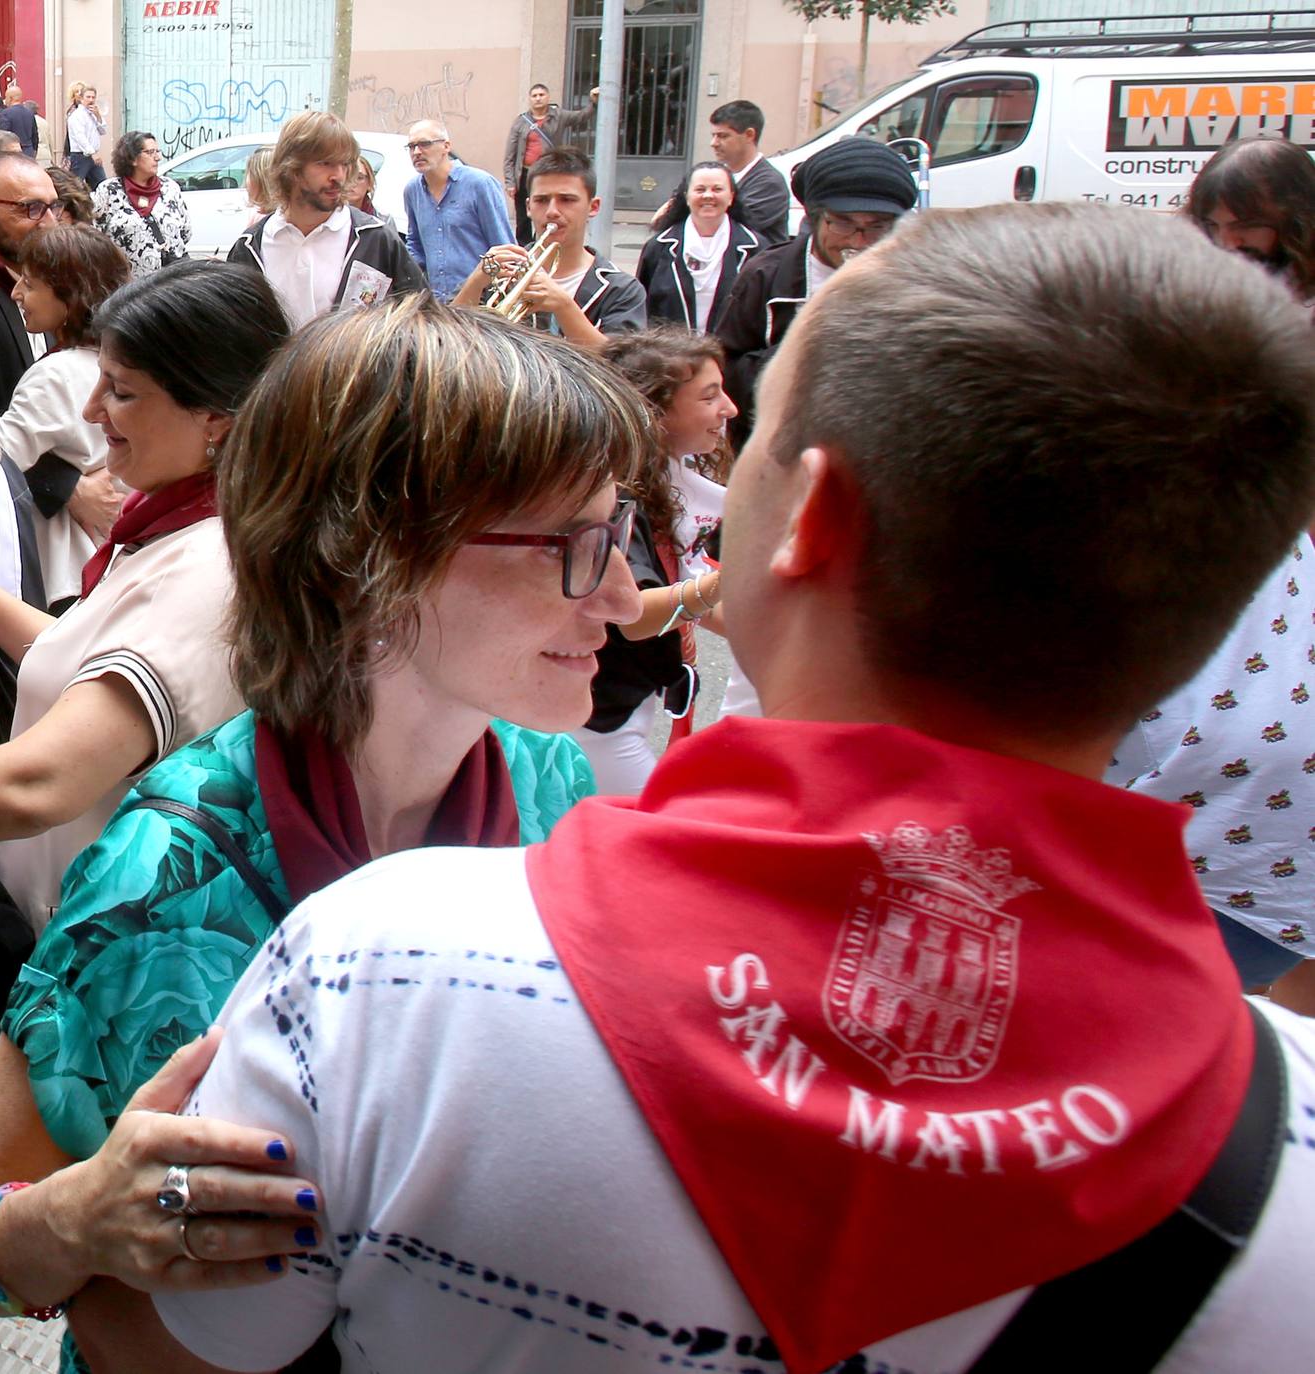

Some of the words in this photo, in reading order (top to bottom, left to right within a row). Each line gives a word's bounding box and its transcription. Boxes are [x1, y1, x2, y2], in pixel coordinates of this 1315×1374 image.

[143, 0, 220, 18] KEBIR
[157, 23, 185, 33] 609
[189, 23, 207, 32] 54
[214, 23, 231, 31] 79
[236, 22, 254, 31] 56
[1120, 193, 1159, 207] 941
[705, 952, 827, 1112] SAN
[838, 1083, 1133, 1177] MATEO
